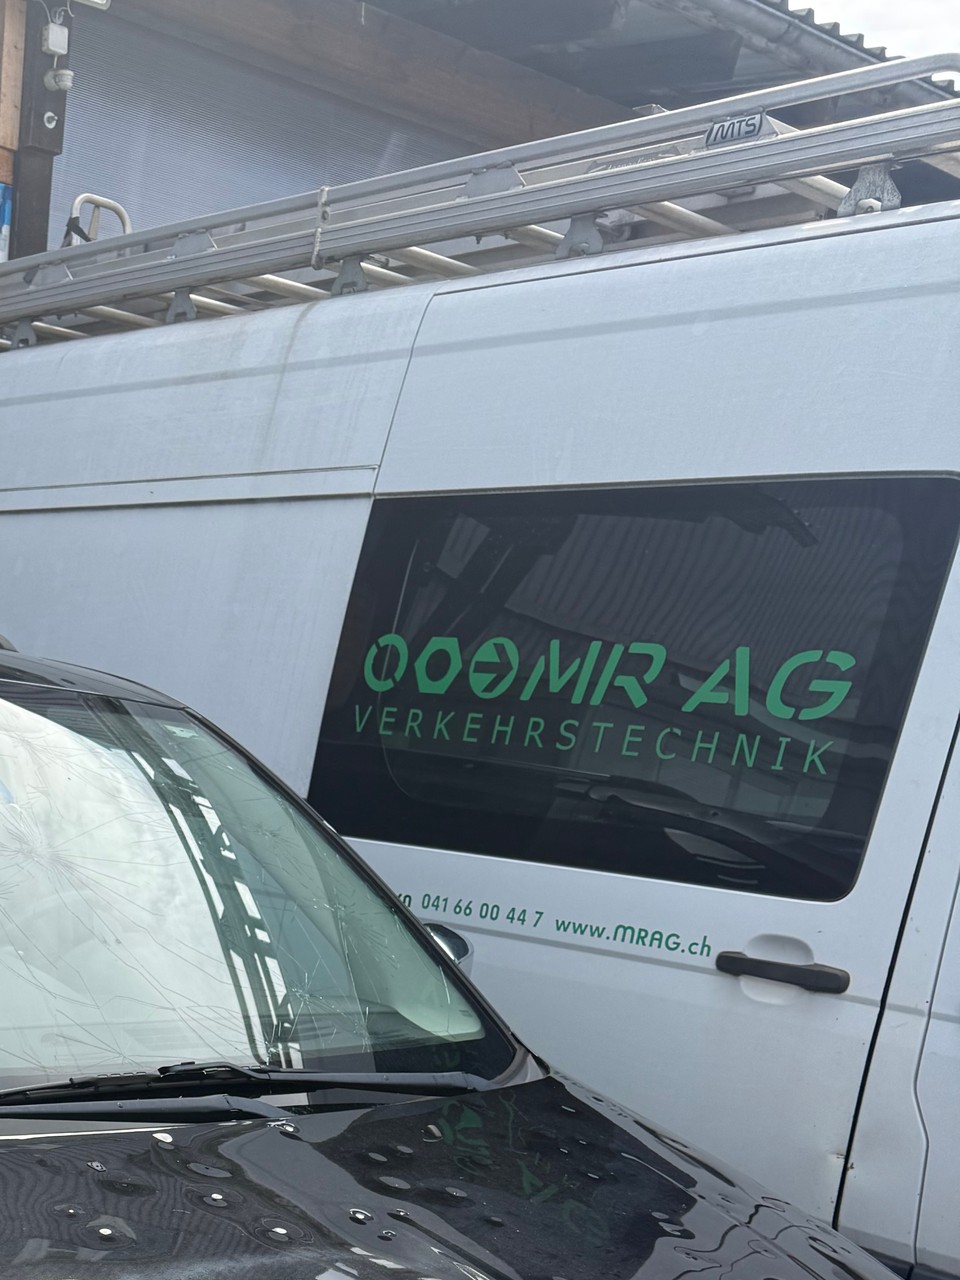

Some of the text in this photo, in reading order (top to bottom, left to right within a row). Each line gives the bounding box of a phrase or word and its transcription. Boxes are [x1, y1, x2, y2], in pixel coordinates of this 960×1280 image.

[713, 116, 757, 142] MTS
[680, 646, 857, 721] AG
[354, 703, 835, 776] VERKEHRSTECHNIK
[421, 893, 449, 913] 041
[453, 898, 473, 917] 66
[479, 902, 500, 921] 00
[506, 907, 527, 926] 44
[532, 910, 544, 928] 7
[555, 918, 712, 958] www.MRAG.ch
